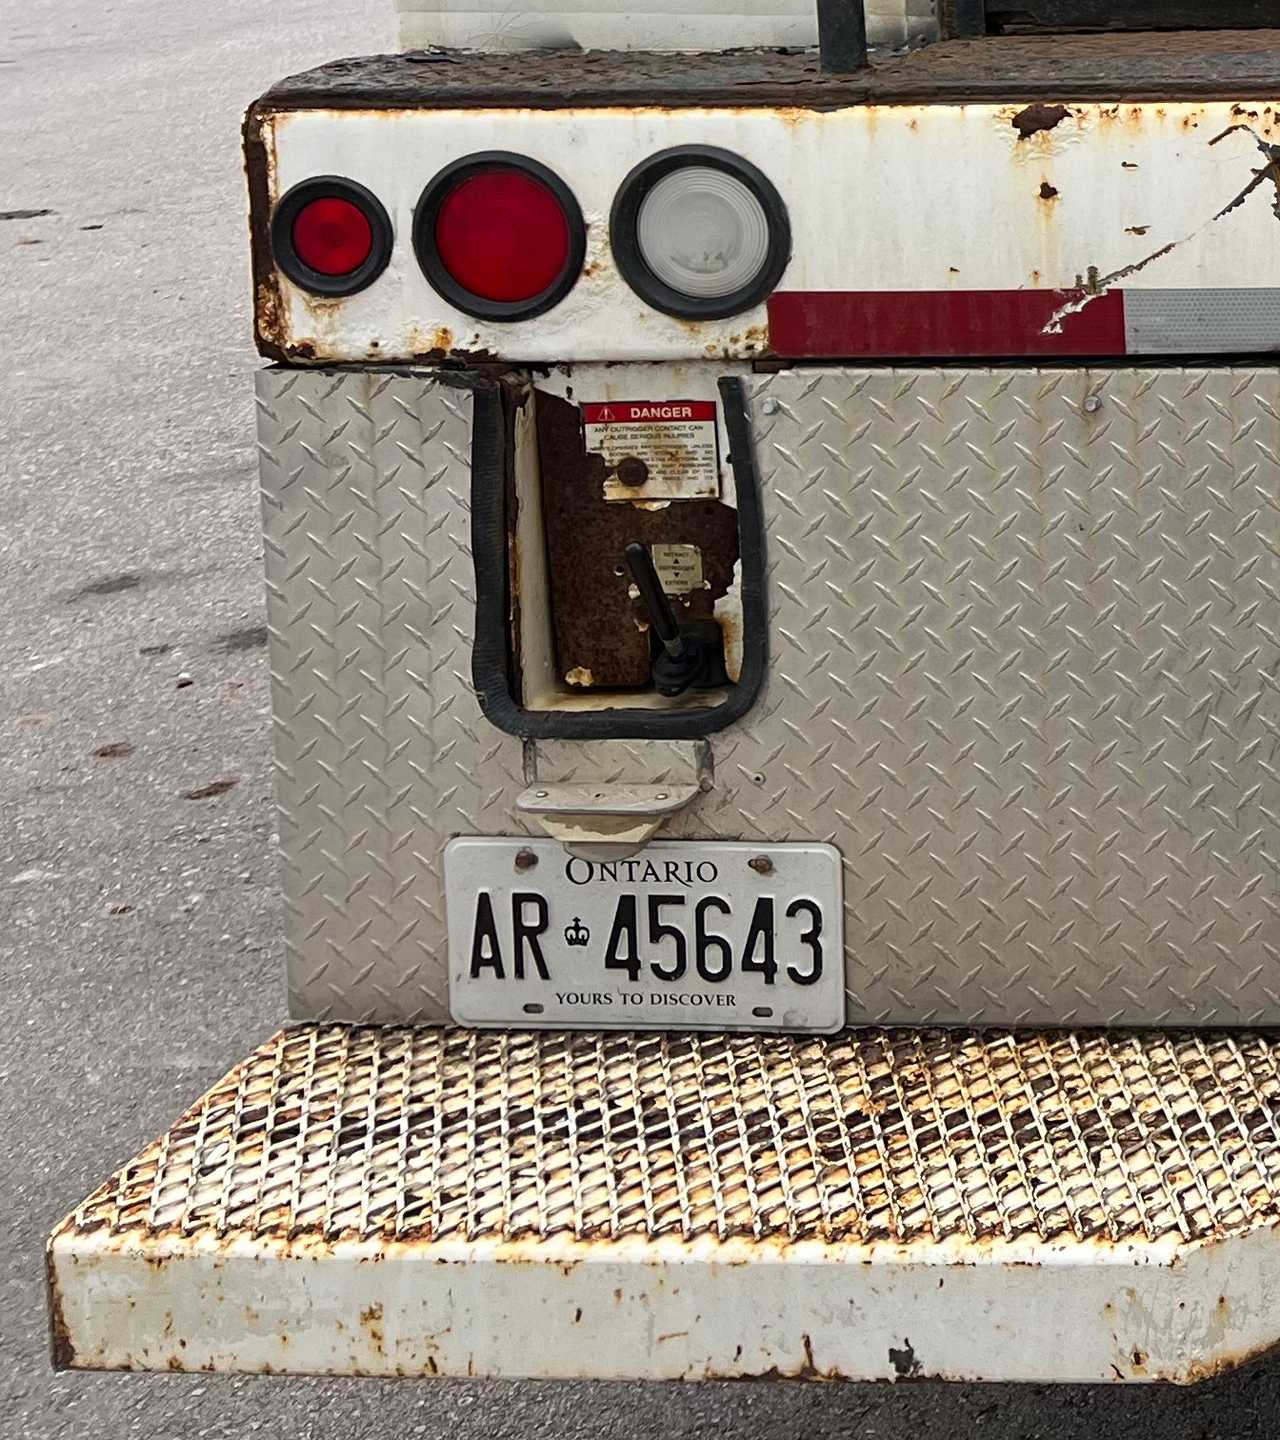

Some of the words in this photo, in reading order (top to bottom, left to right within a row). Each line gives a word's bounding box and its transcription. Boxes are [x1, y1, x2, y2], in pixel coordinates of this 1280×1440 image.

[631, 407, 692, 418] DANGER
[565, 856, 719, 887] ONTARIO
[469, 891, 551, 981] AR
[604, 894, 824, 986] 45643
[555, 991, 613, 1006] YOURS
[619, 992, 644, 1006] TO
[650, 993, 737, 1007] DISCOVER
